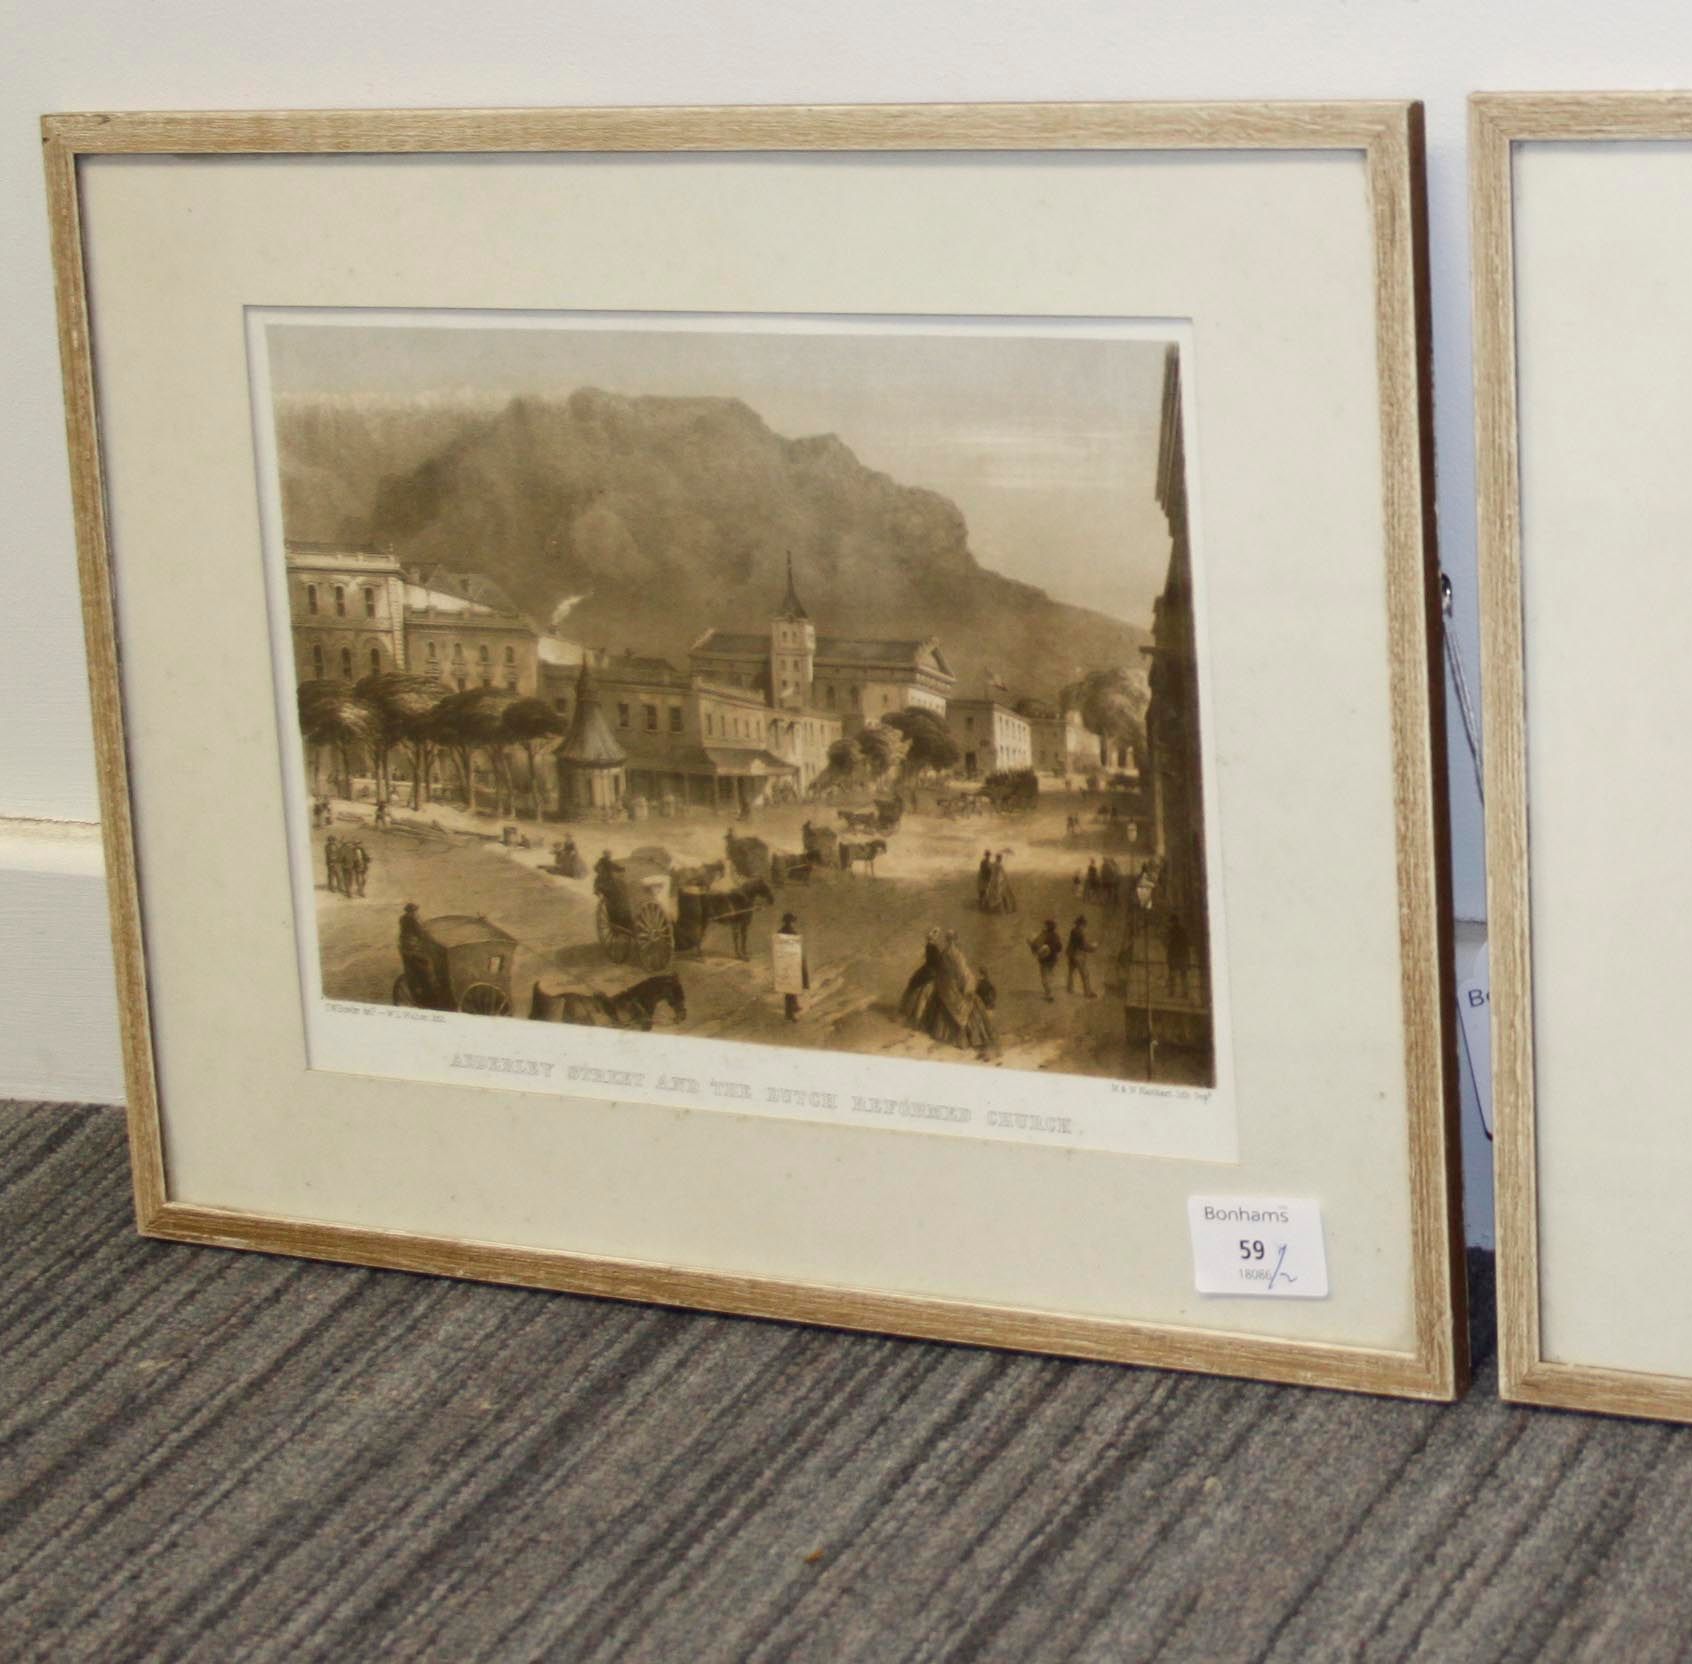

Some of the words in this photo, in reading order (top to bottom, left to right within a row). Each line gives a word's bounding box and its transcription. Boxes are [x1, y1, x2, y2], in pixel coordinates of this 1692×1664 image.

[1468, 987, 1489, 1008] B
[450, 1052, 555, 1079] ADDERLEY
[567, 1064, 648, 1088] STREET
[655, 1073, 701, 1094] AND
[710, 1077, 752, 1099] THE
[766, 1087, 838, 1110] DUTCH
[850, 1095, 973, 1123] REFORMED
[1203, 1205, 1289, 1223] Bonhams
[1239, 1239, 1265, 1260] 59
